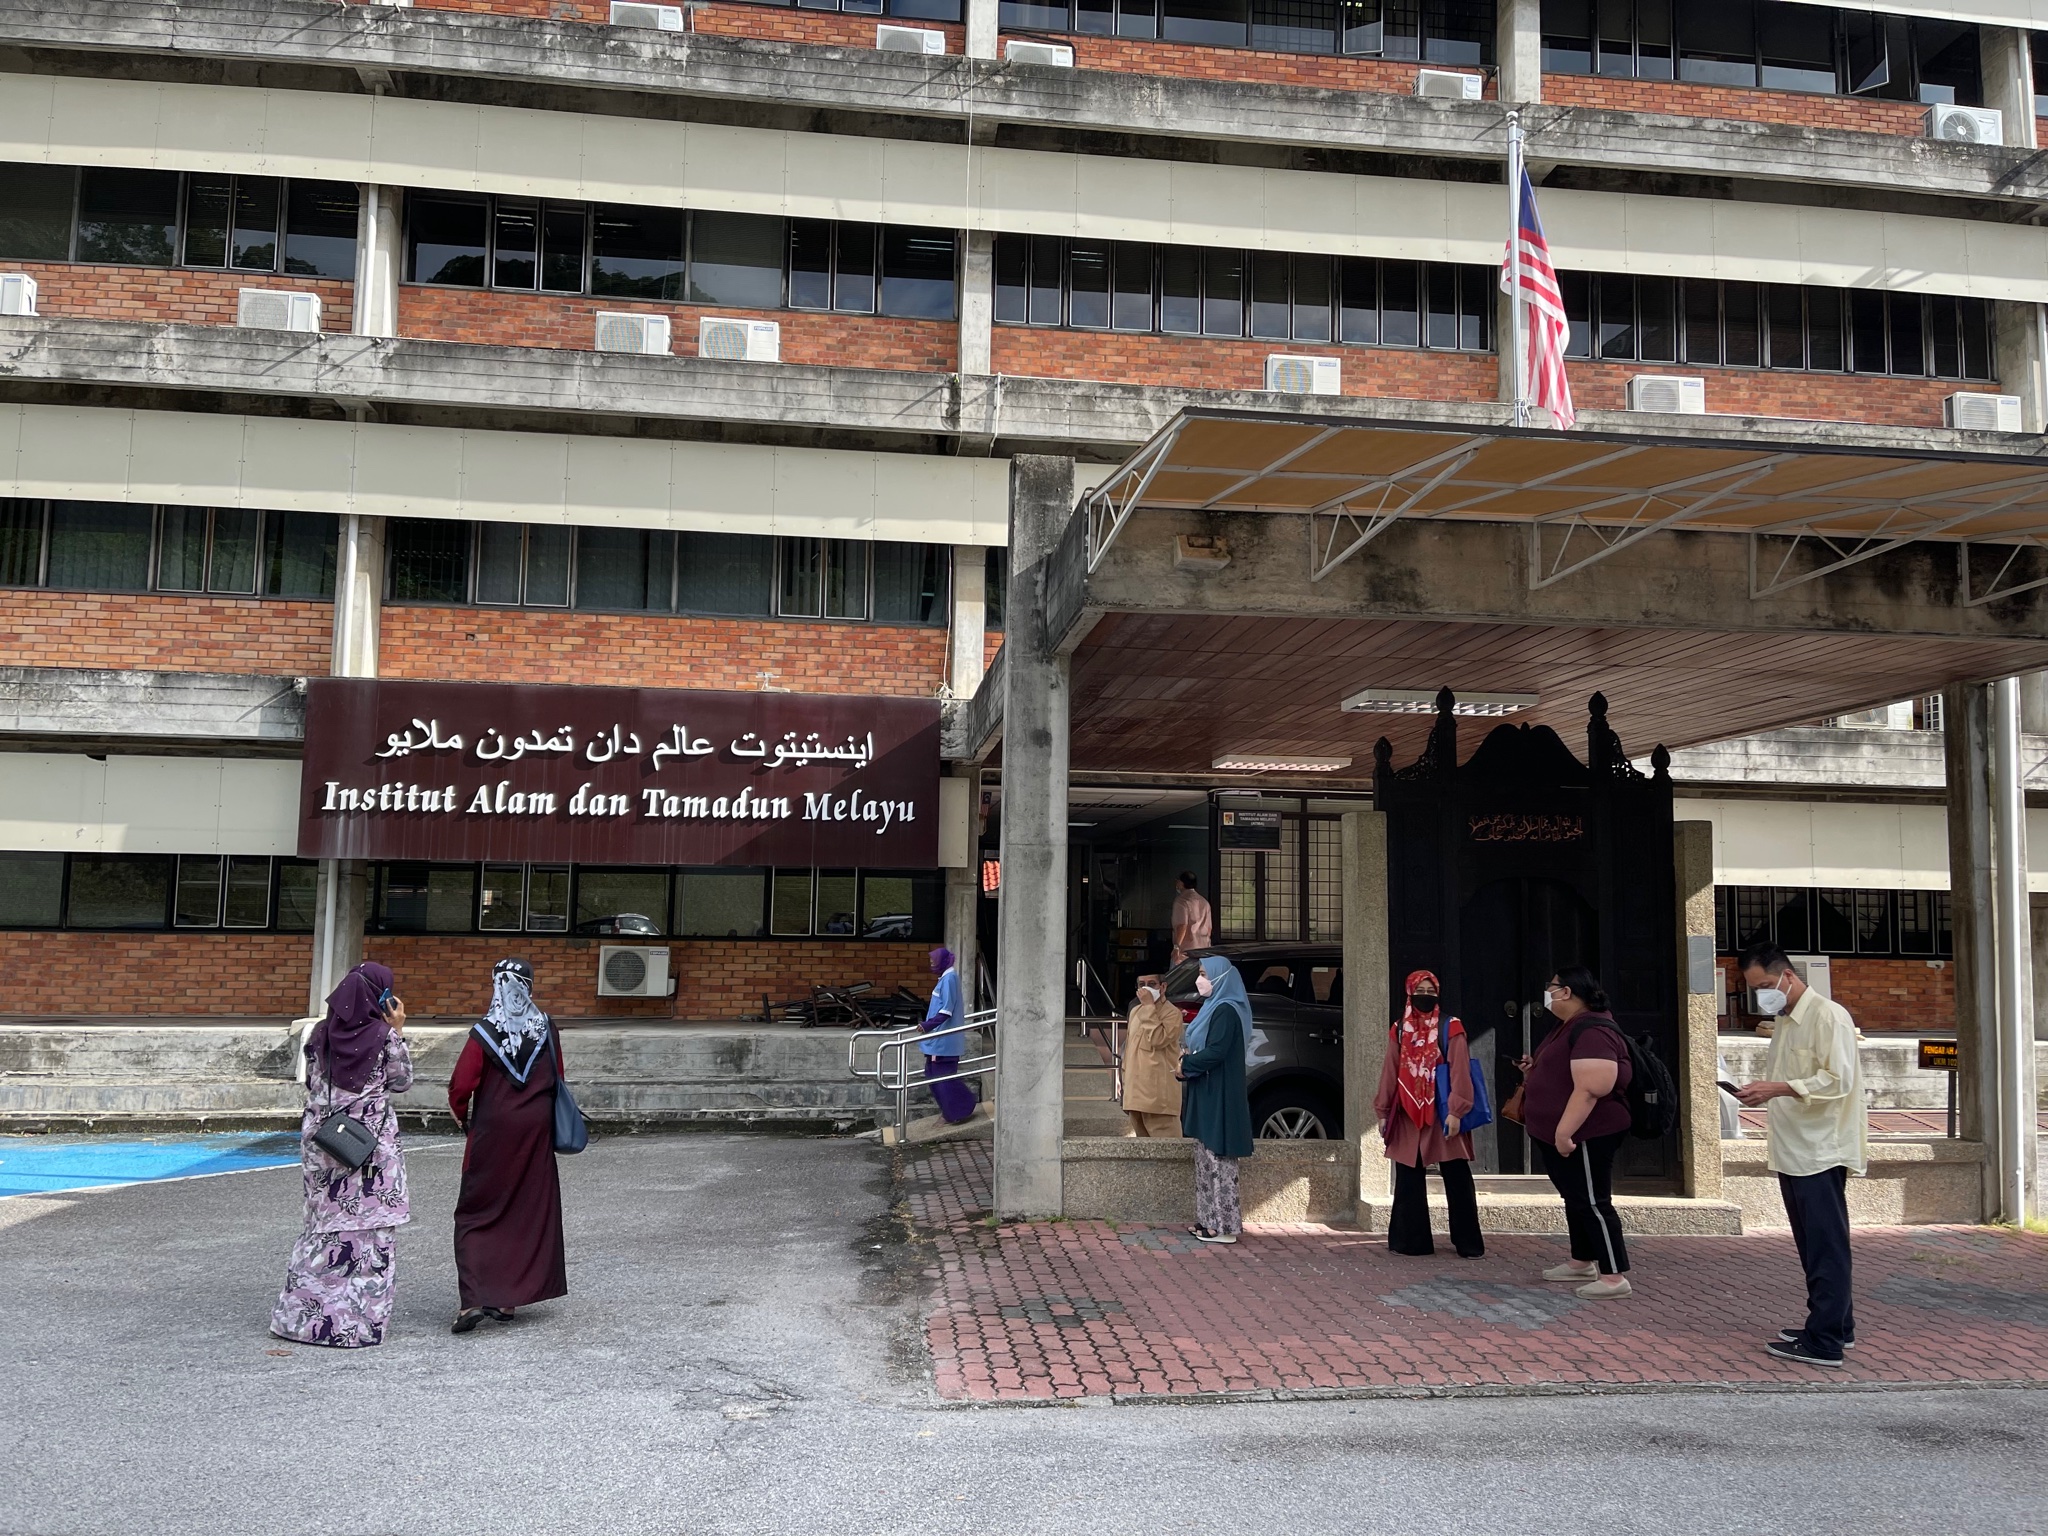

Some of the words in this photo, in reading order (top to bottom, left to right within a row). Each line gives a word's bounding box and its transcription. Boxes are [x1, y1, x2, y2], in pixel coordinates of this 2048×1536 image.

[375, 718, 463, 757] ملايو
[475, 725, 574, 760] تمدون
[586, 723, 642, 762] دان
[652, 723, 715, 771] عالم
[730, 731, 874, 768] اينستيتوت
[321, 780, 457, 813] Institut
[466, 781, 557, 816] Alam
[569, 782, 630, 816] dan
[642, 785, 792, 820] Tamadun
[801, 789, 916, 835] Melayu
